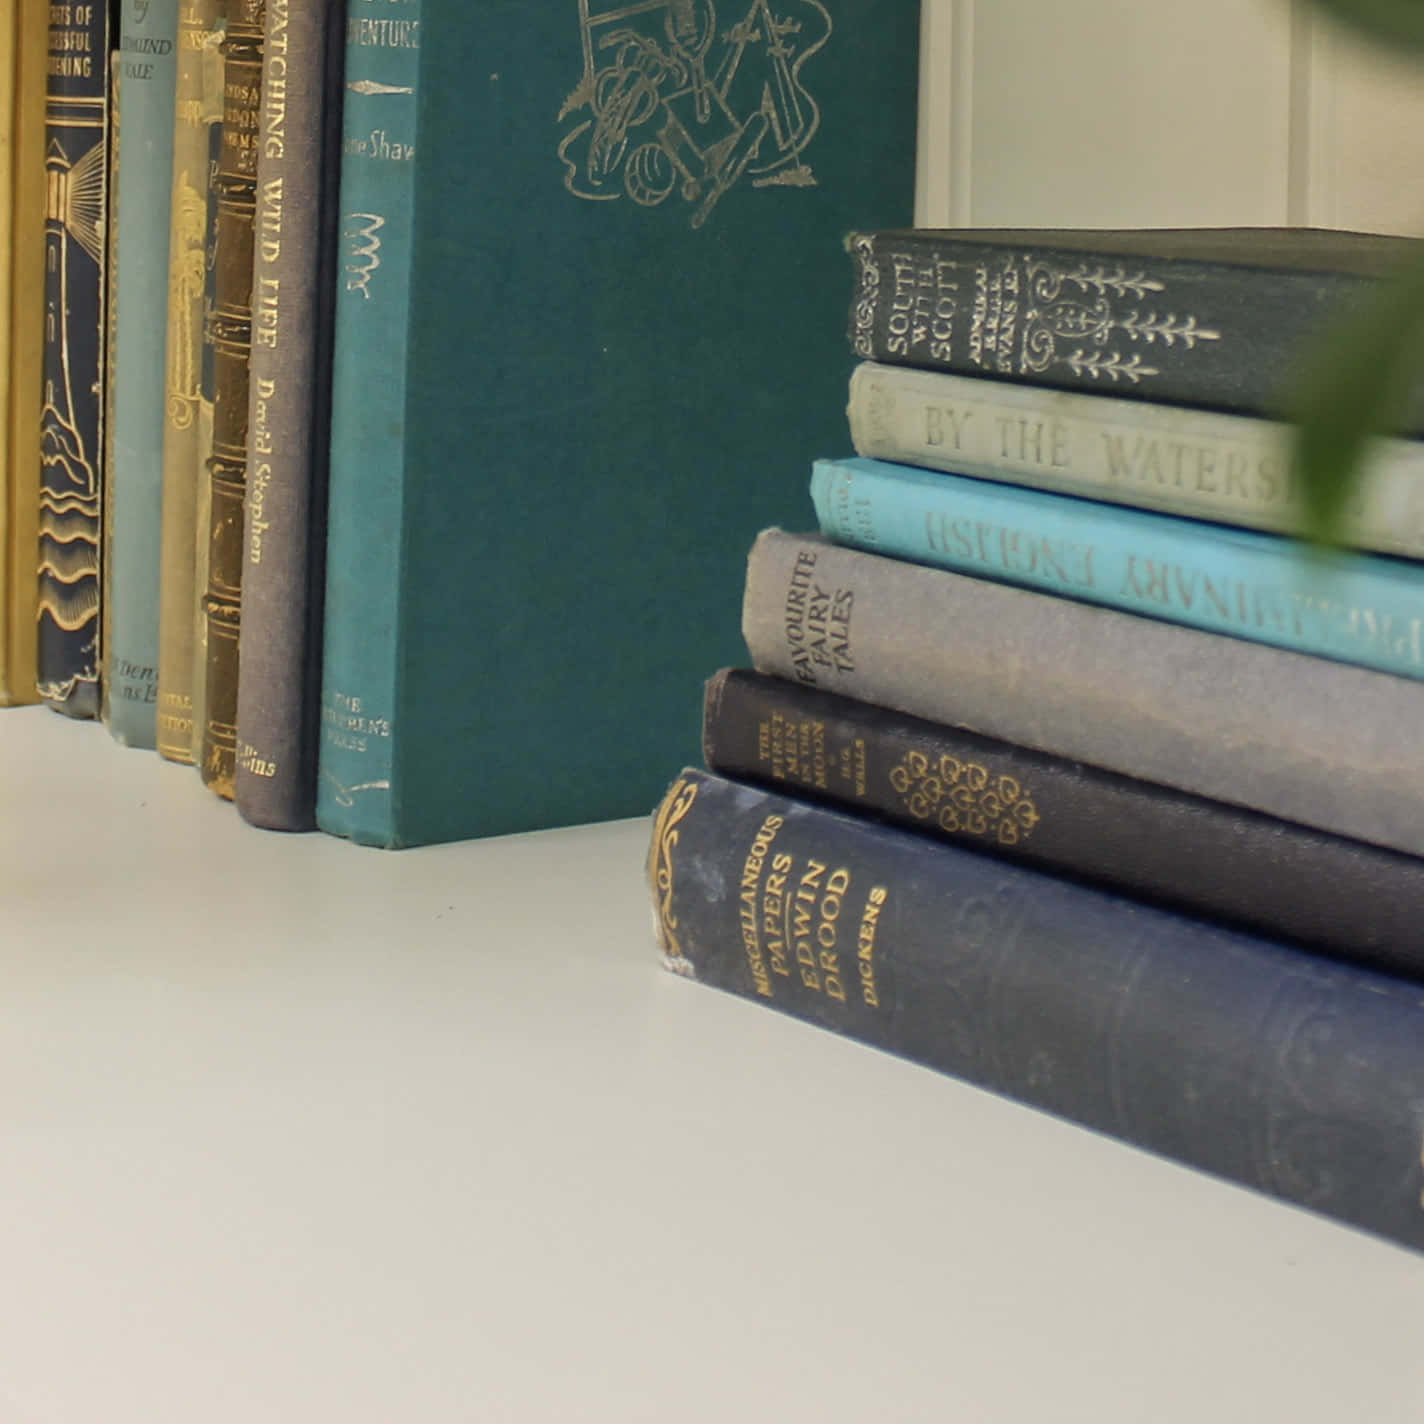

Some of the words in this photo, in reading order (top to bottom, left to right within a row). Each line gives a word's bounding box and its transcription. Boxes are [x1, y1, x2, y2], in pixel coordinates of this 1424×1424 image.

[75, 4, 93, 25] OF
[260, 177, 284, 263] WILD
[257, 279, 280, 348] LIFE
[888, 253, 915, 357] SOUTH
[930, 260, 959, 363] SCOTT
[255, 378, 276, 456] David
[925, 406, 972, 451] BY
[994, 415, 1074, 469] THE
[249, 460, 274, 565] Stephen
[923, 509, 1097, 590] ENGLISH
[784, 550, 818, 684] FAVOURITE
[808, 584, 832, 668] FAIRY
[830, 588, 855, 673] TALES
[739, 814, 785, 998] MISCELLANEOUS
[763, 853, 793, 978] PAPERS
[792, 859, 827, 992] EDWIN
[816, 867, 852, 1002] DROOD
[856, 886, 889, 1008] DICKENS
